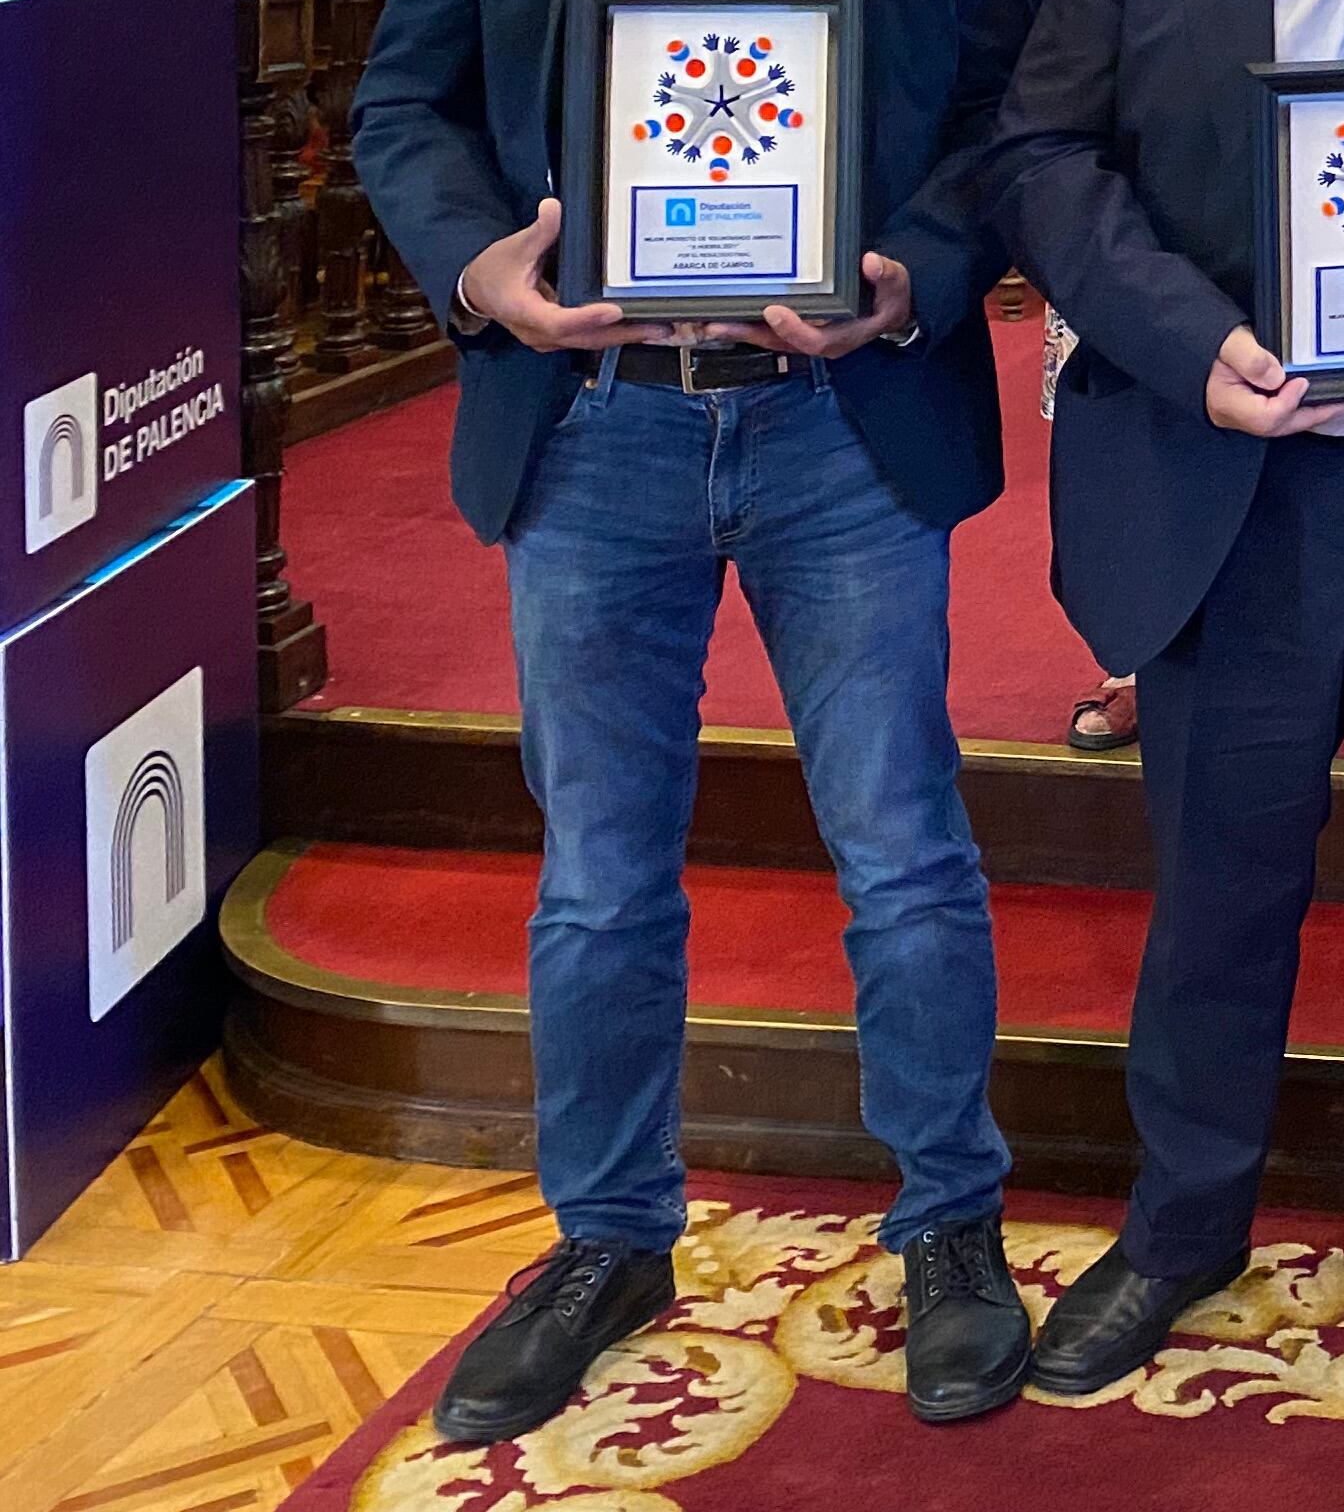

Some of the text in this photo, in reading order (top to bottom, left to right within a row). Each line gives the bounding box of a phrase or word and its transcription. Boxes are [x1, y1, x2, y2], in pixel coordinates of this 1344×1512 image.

[104, 346, 204, 427] Diputación
[104, 383, 224, 482] DE PALENCIA
